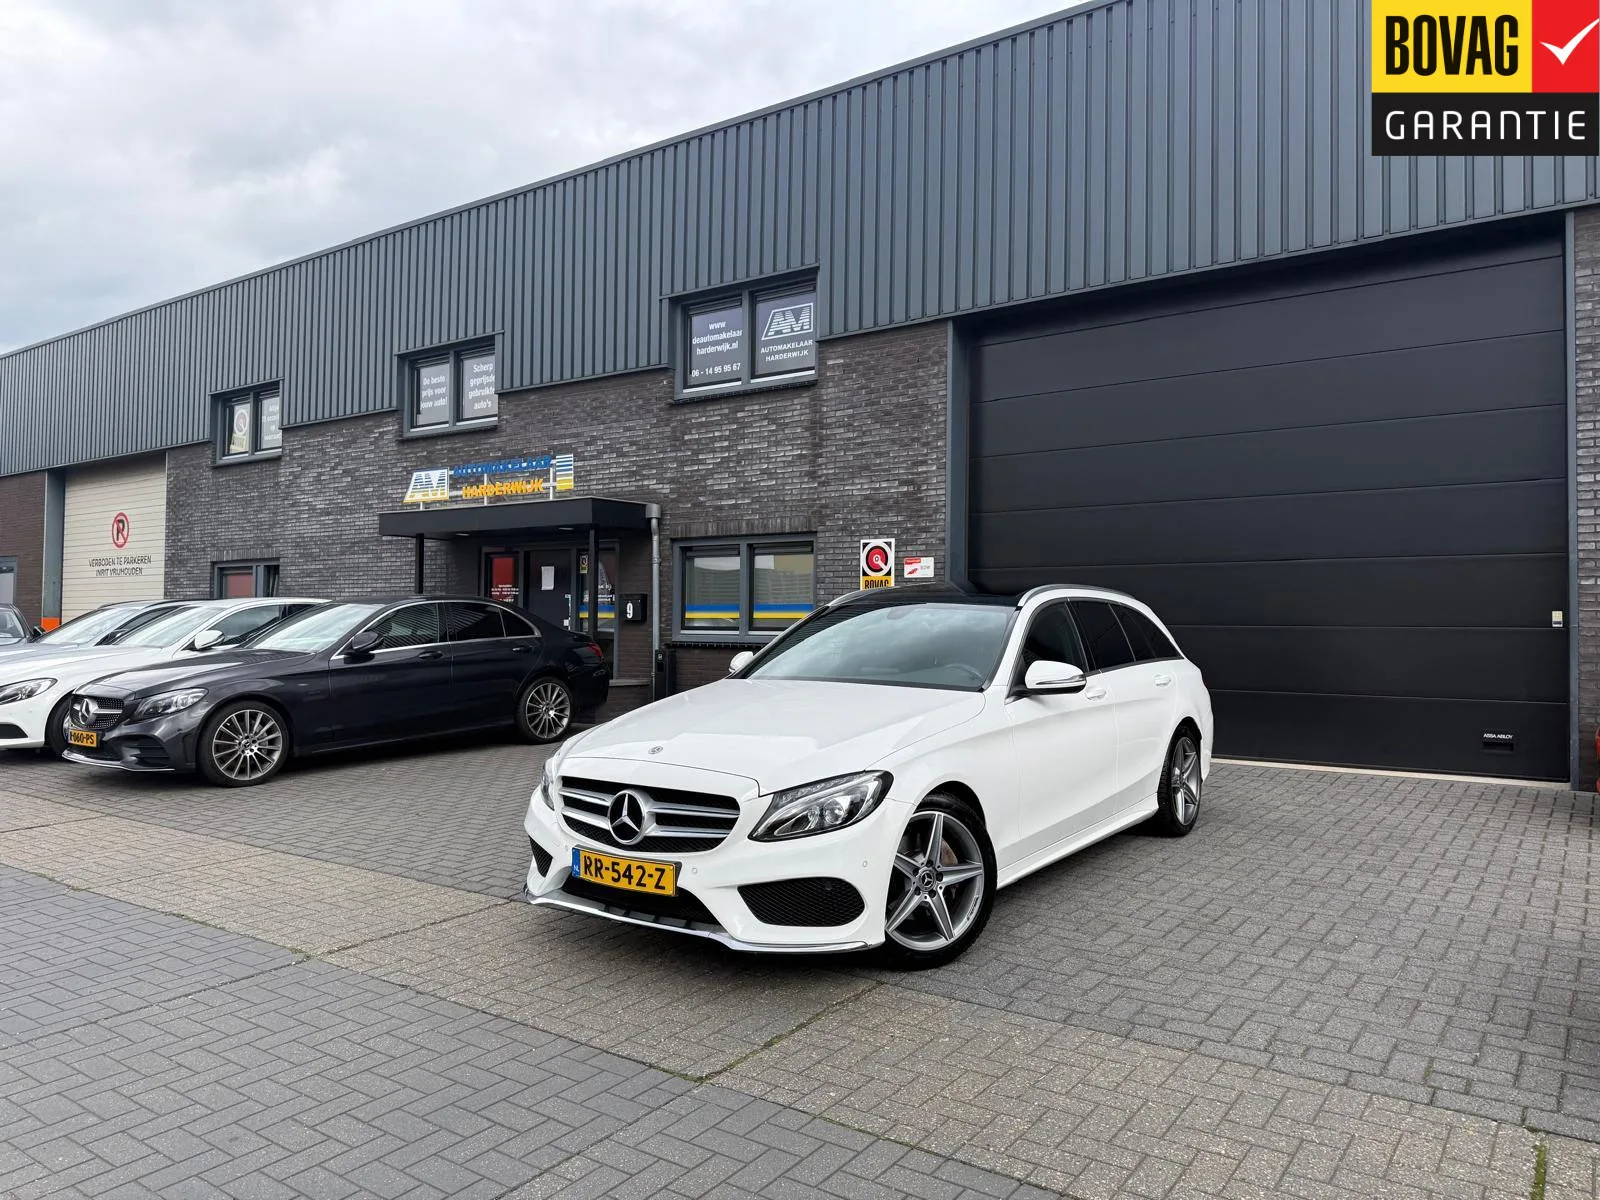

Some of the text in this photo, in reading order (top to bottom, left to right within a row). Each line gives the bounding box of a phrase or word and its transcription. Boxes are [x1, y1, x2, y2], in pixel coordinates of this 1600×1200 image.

[708, 321, 726, 330] www
[692, 329, 743, 345] deautomakelaar
[696, 341, 739, 356] harderwijk.nl
[760, 339, 814, 354] AUTOMAKELAAR
[765, 349, 809, 362] HARDERWIJK
[473, 363, 494, 373] Scherp
[691, 369, 700, 378] 06
[705, 367, 713, 375] 14
[714, 366, 722, 374] 95
[723, 364, 732, 372] 95
[453, 455, 552, 478] AUTOMAKELAAR
[462, 478, 545, 499] HARDERWIJK
[88, 555, 152, 568] VERBODEN TE PARKEREN
[626, 602, 634, 619] 9
[583, 855, 666, 891] RR-542-Z
